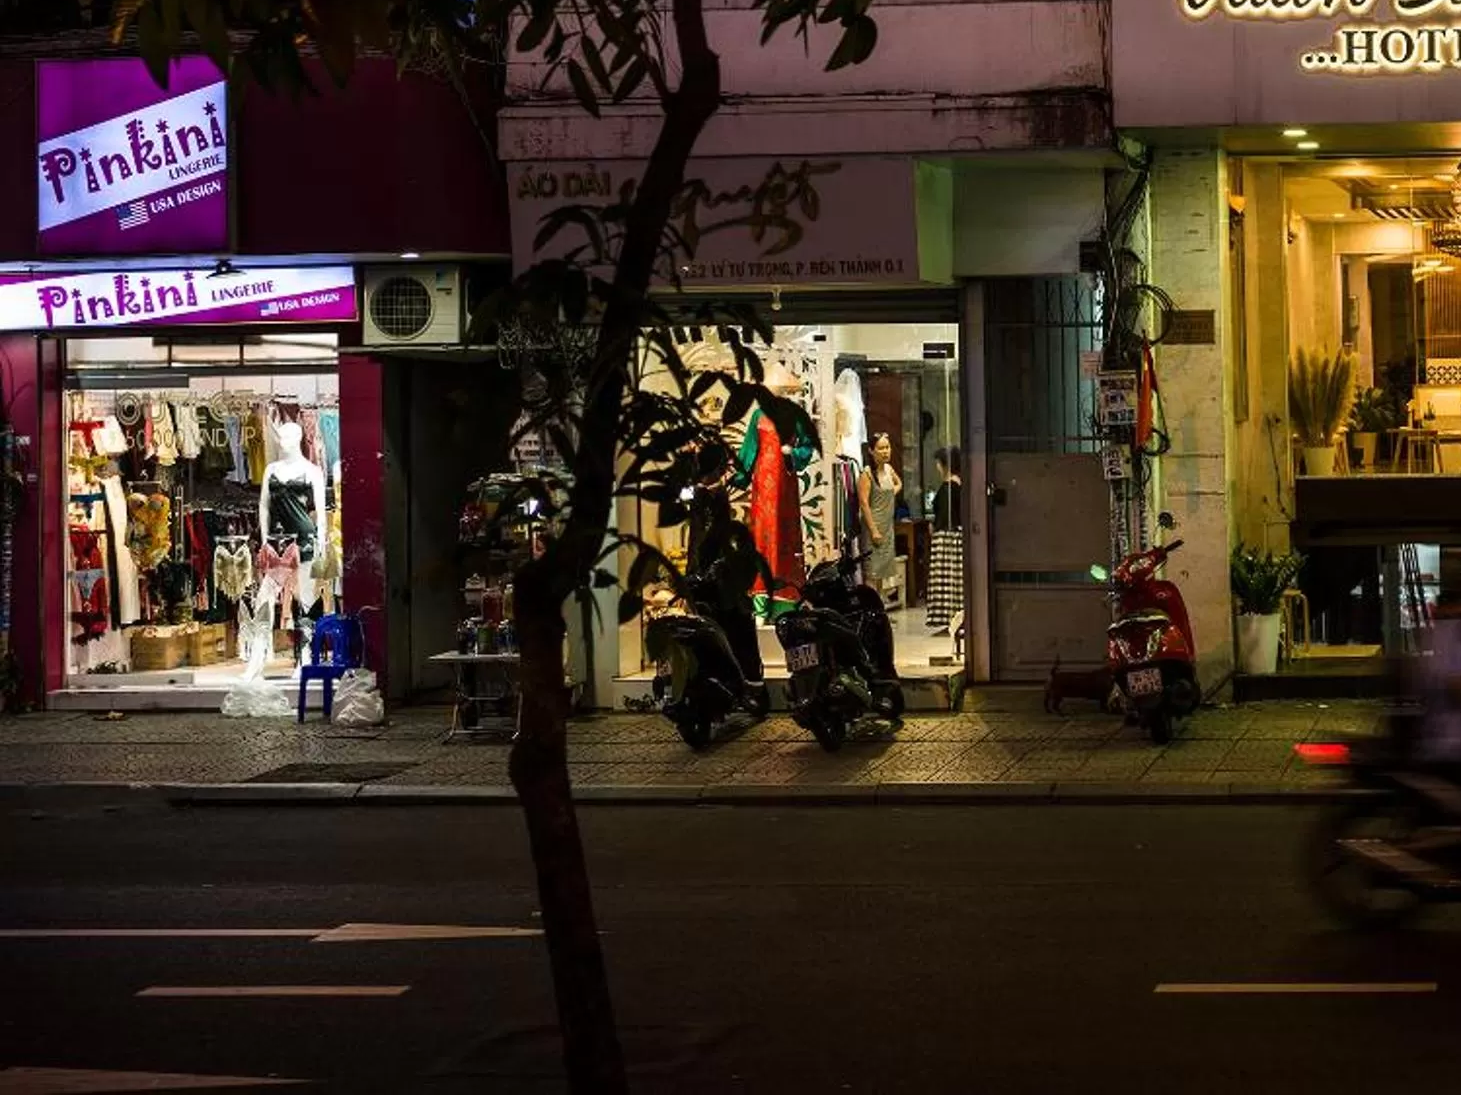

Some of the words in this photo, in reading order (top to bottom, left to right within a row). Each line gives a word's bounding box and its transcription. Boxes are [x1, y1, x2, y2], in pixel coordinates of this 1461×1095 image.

[40, 101, 226, 203] Pinkini
[168, 153, 225, 181] LINGERIE
[150, 196, 174, 214] USA
[177, 180, 222, 205] DESIGN
[37, 271, 198, 328] Pinkini
[211, 280, 276, 303] LINGERIE
[278, 299, 300, 312] USA
[301, 291, 341, 308] DESIGN
